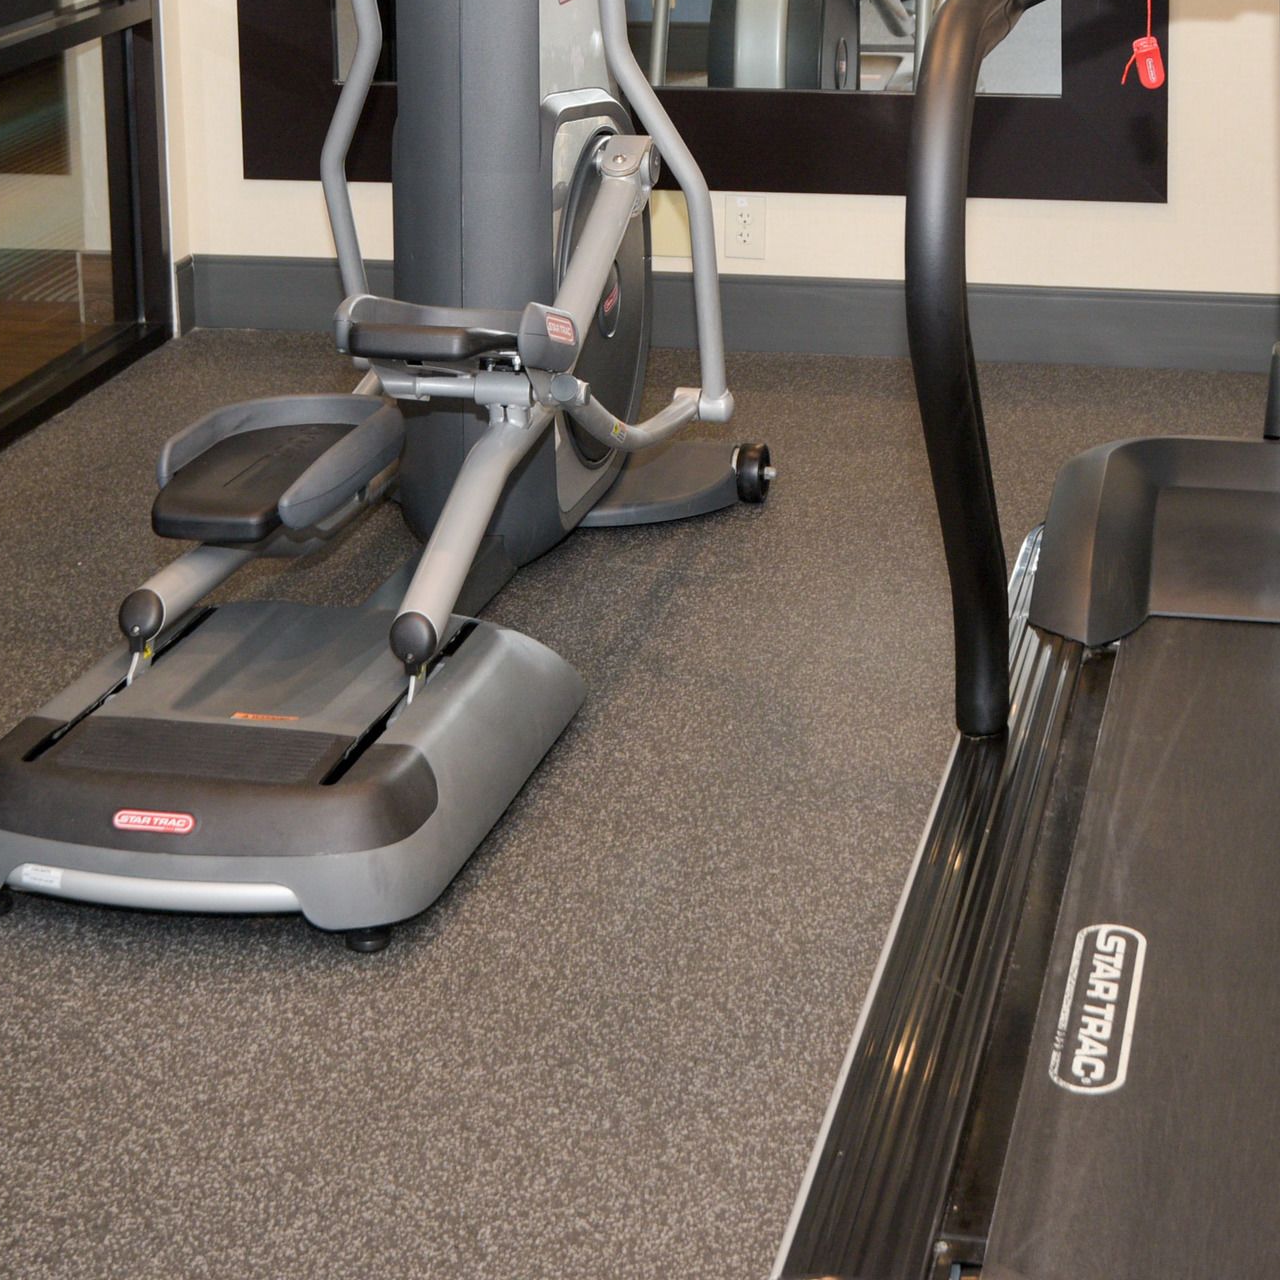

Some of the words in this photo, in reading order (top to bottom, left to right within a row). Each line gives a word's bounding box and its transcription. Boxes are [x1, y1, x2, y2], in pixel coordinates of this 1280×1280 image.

[119, 814, 151, 825] STAR
[152, 817, 186, 827] TRAC
[1086, 928, 1127, 1002] STAR
[1072, 1003, 1115, 1081] TRAC
